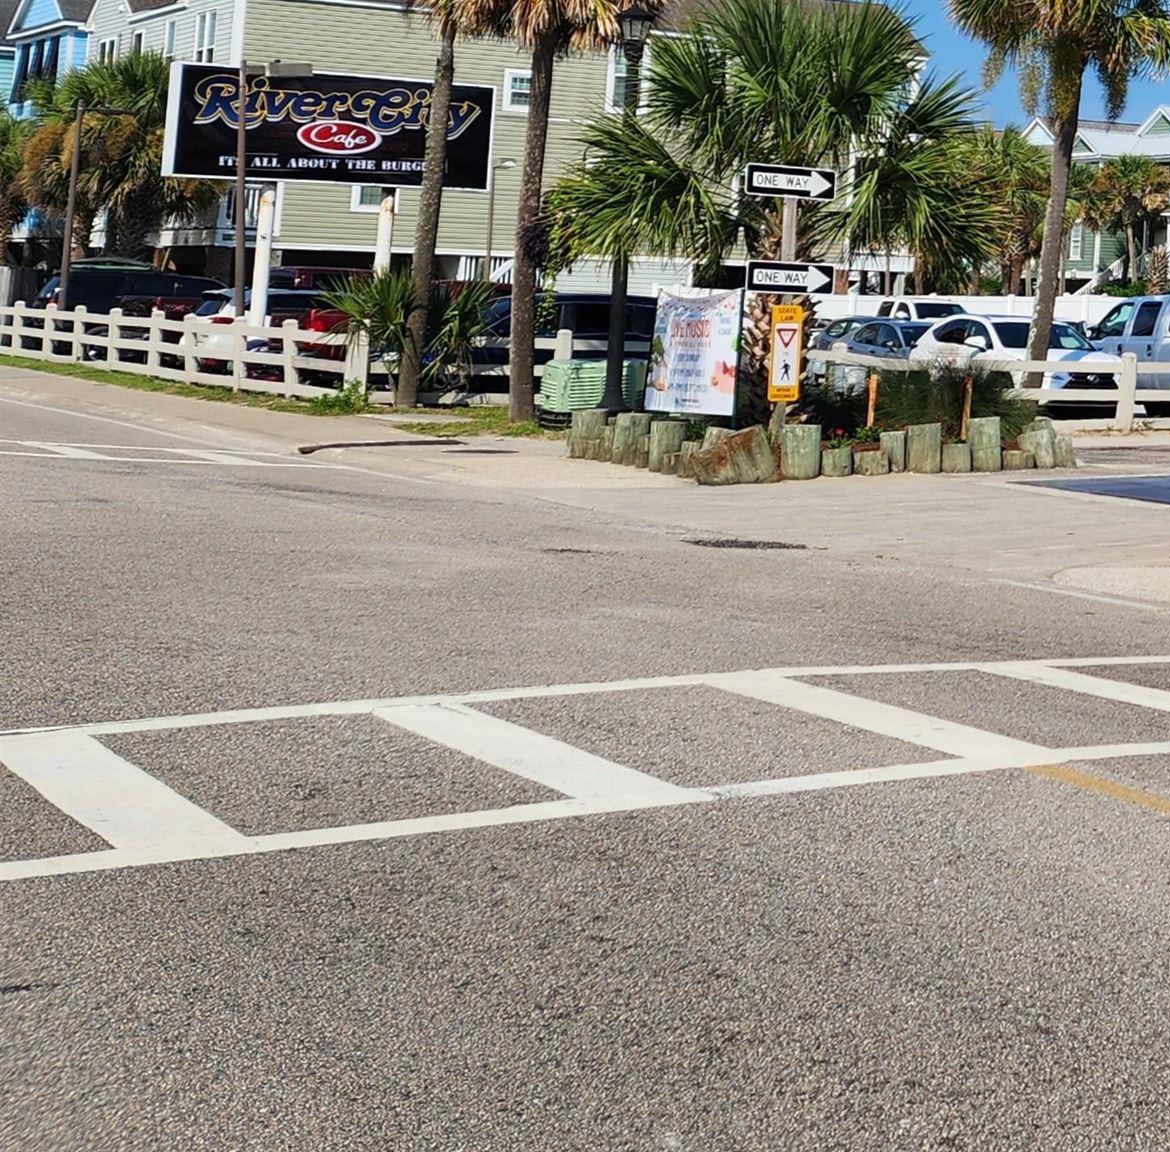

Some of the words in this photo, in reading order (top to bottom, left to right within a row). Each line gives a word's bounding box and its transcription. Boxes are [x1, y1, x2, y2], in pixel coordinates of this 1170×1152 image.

[193, 74, 350, 129] River
[310, 122, 367, 148] Cafe
[250, 157, 281, 168] ALL
[287, 158, 340, 169] ABOUT
[346, 159, 377, 171] THE
[757, 174, 779, 187] ONE
[786, 176, 809, 189] WAY
[756, 271, 779, 284] ONE
[784, 272, 808, 286] WAY
